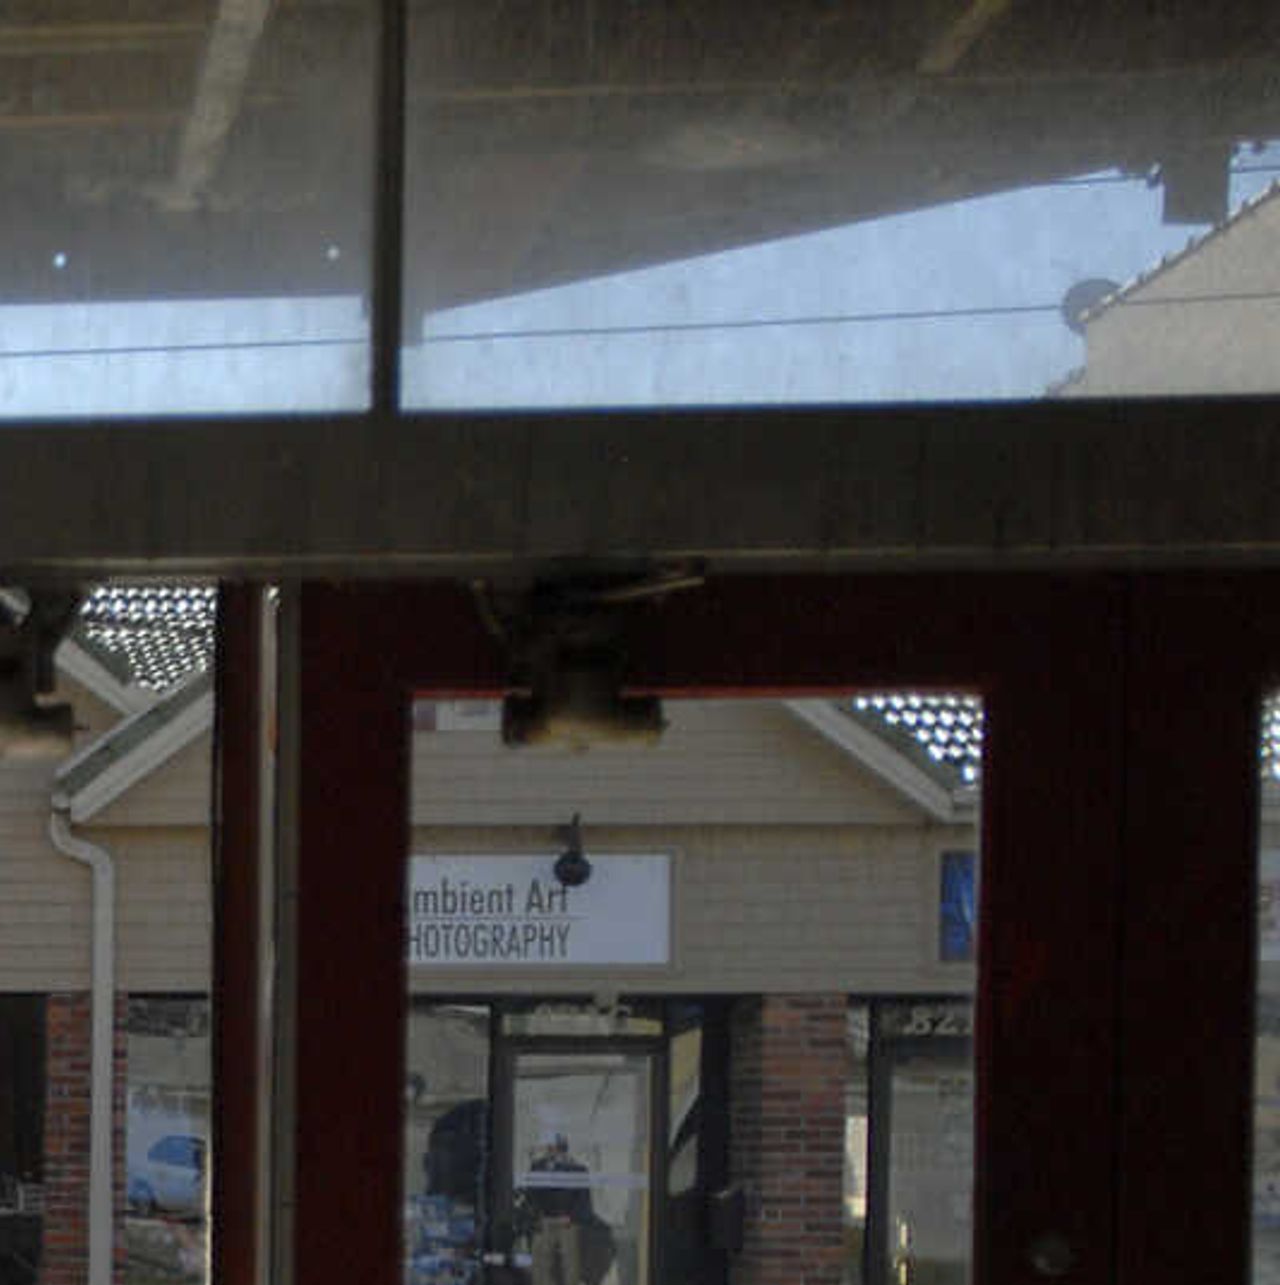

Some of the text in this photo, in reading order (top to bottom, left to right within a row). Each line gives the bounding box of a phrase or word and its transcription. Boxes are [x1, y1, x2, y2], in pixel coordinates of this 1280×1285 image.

[412, 878, 570, 915] mbient Art
[409, 923, 571, 960] HOTOGRAPHY
